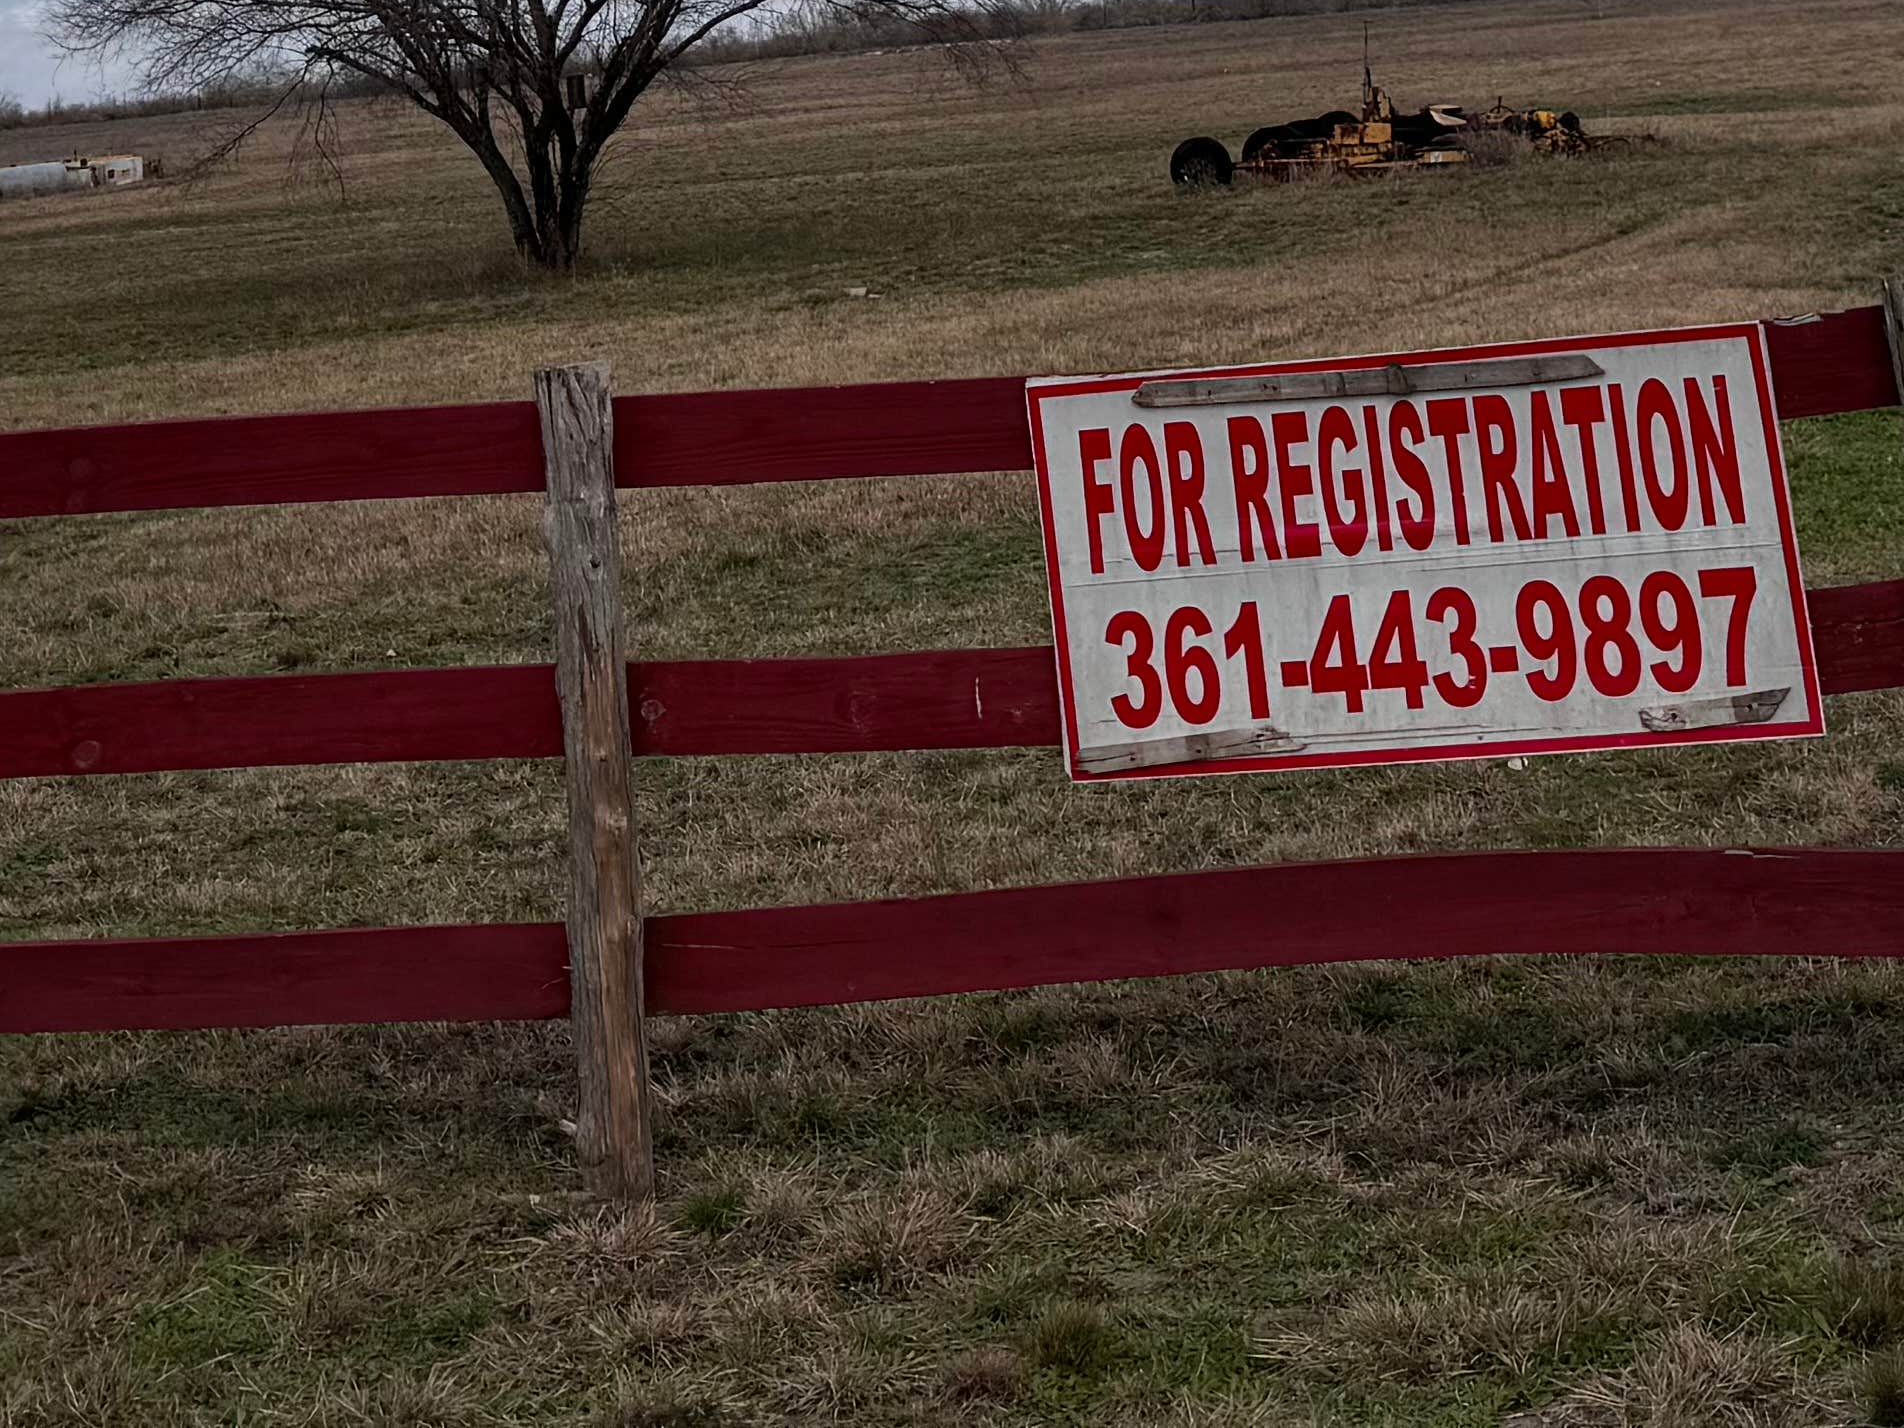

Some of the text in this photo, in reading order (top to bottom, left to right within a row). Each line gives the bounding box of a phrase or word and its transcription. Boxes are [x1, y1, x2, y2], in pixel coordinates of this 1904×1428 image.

[1078, 374, 1747, 574] FOR REGISTRATION
[1104, 565, 1758, 730] 361-443-9897
